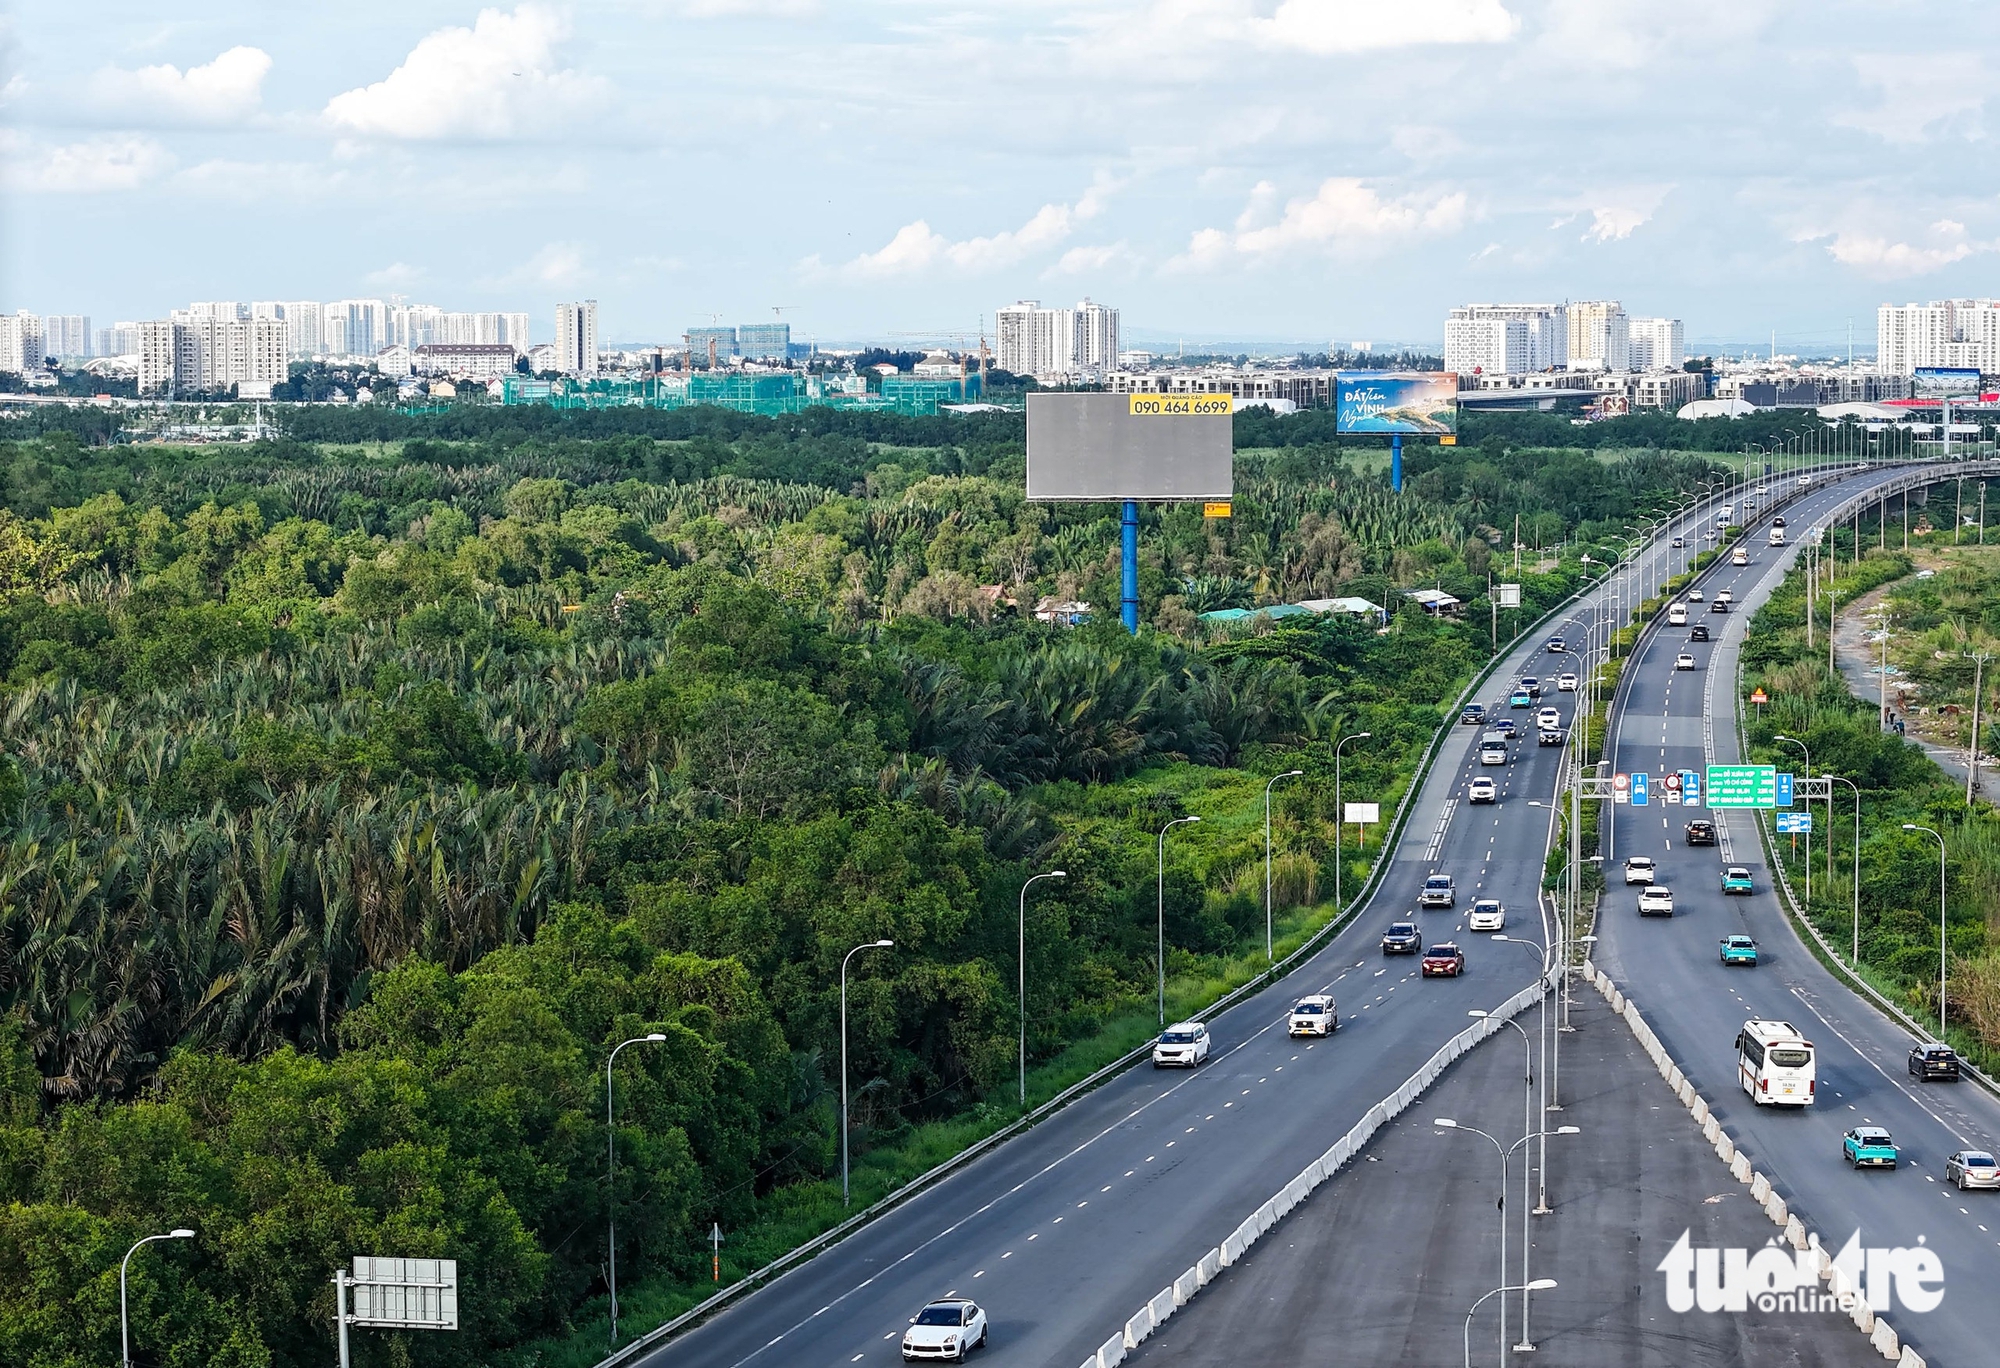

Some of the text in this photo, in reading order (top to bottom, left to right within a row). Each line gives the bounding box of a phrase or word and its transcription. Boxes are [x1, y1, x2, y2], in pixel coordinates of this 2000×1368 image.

[1344, 388, 1367, 402] ĐẤT
[1134, 401, 1228, 414] 090 464 6699
